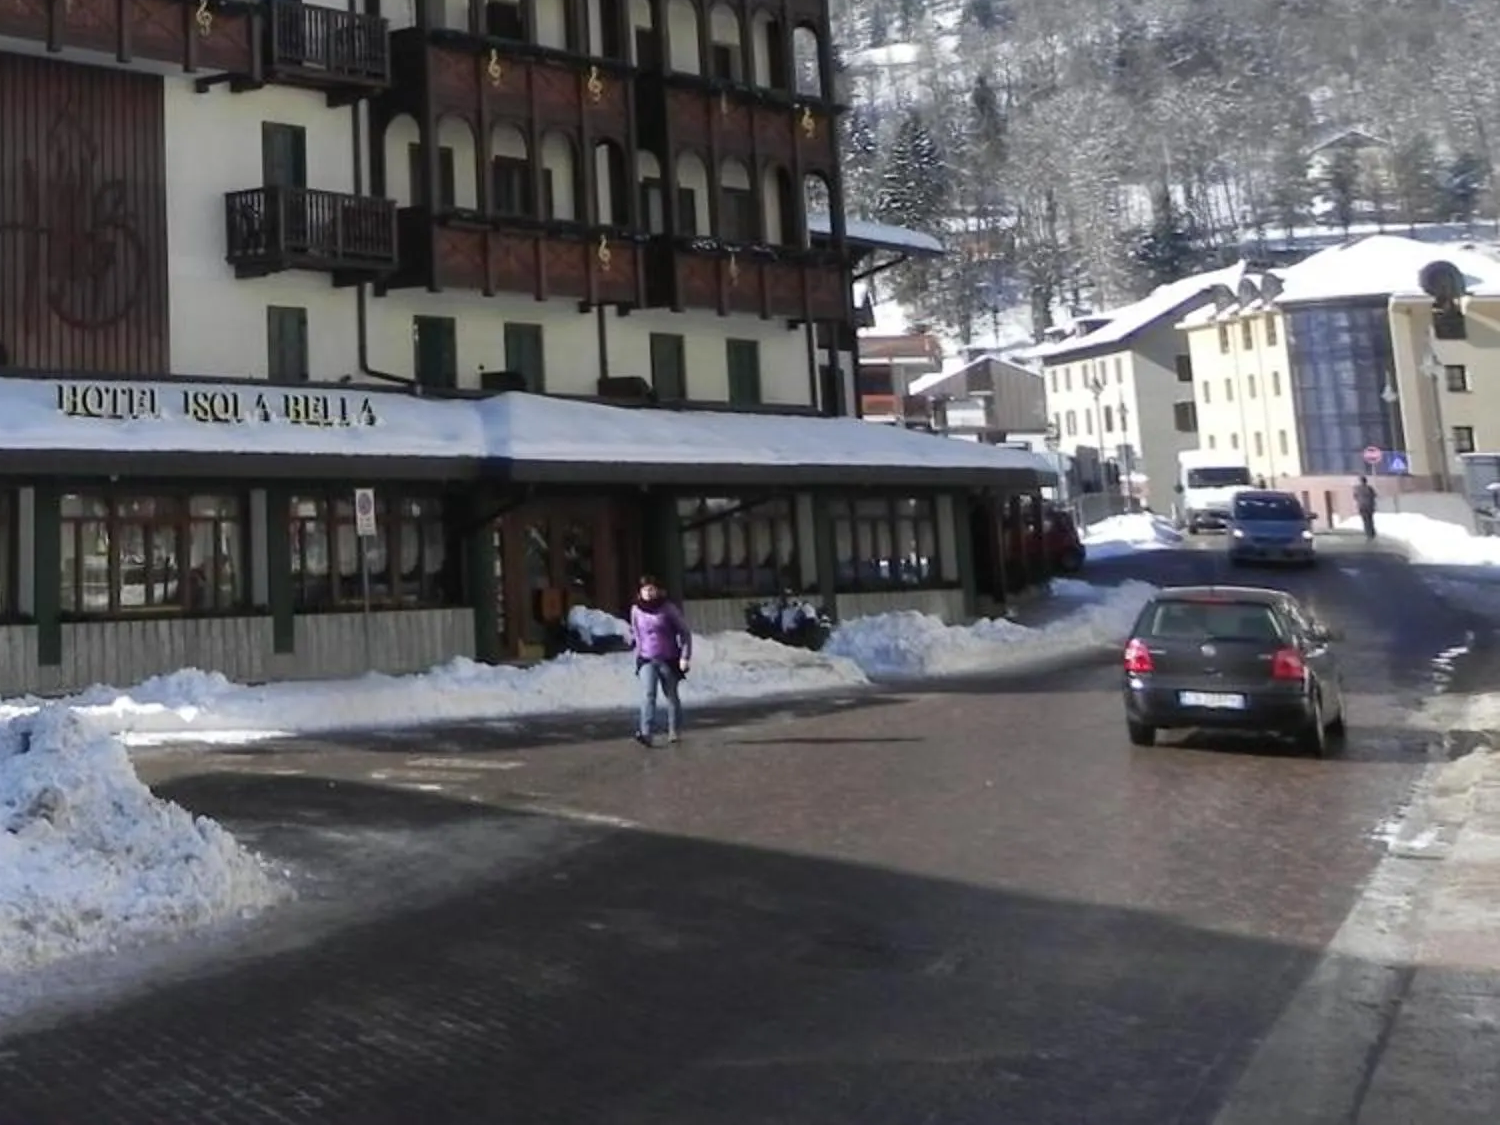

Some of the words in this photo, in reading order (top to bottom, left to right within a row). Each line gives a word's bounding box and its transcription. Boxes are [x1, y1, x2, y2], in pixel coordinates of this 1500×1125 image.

[57, 384, 163, 419] HOTEL
[183, 389, 273, 424] ISOLA
[284, 393, 380, 426] BELLA
